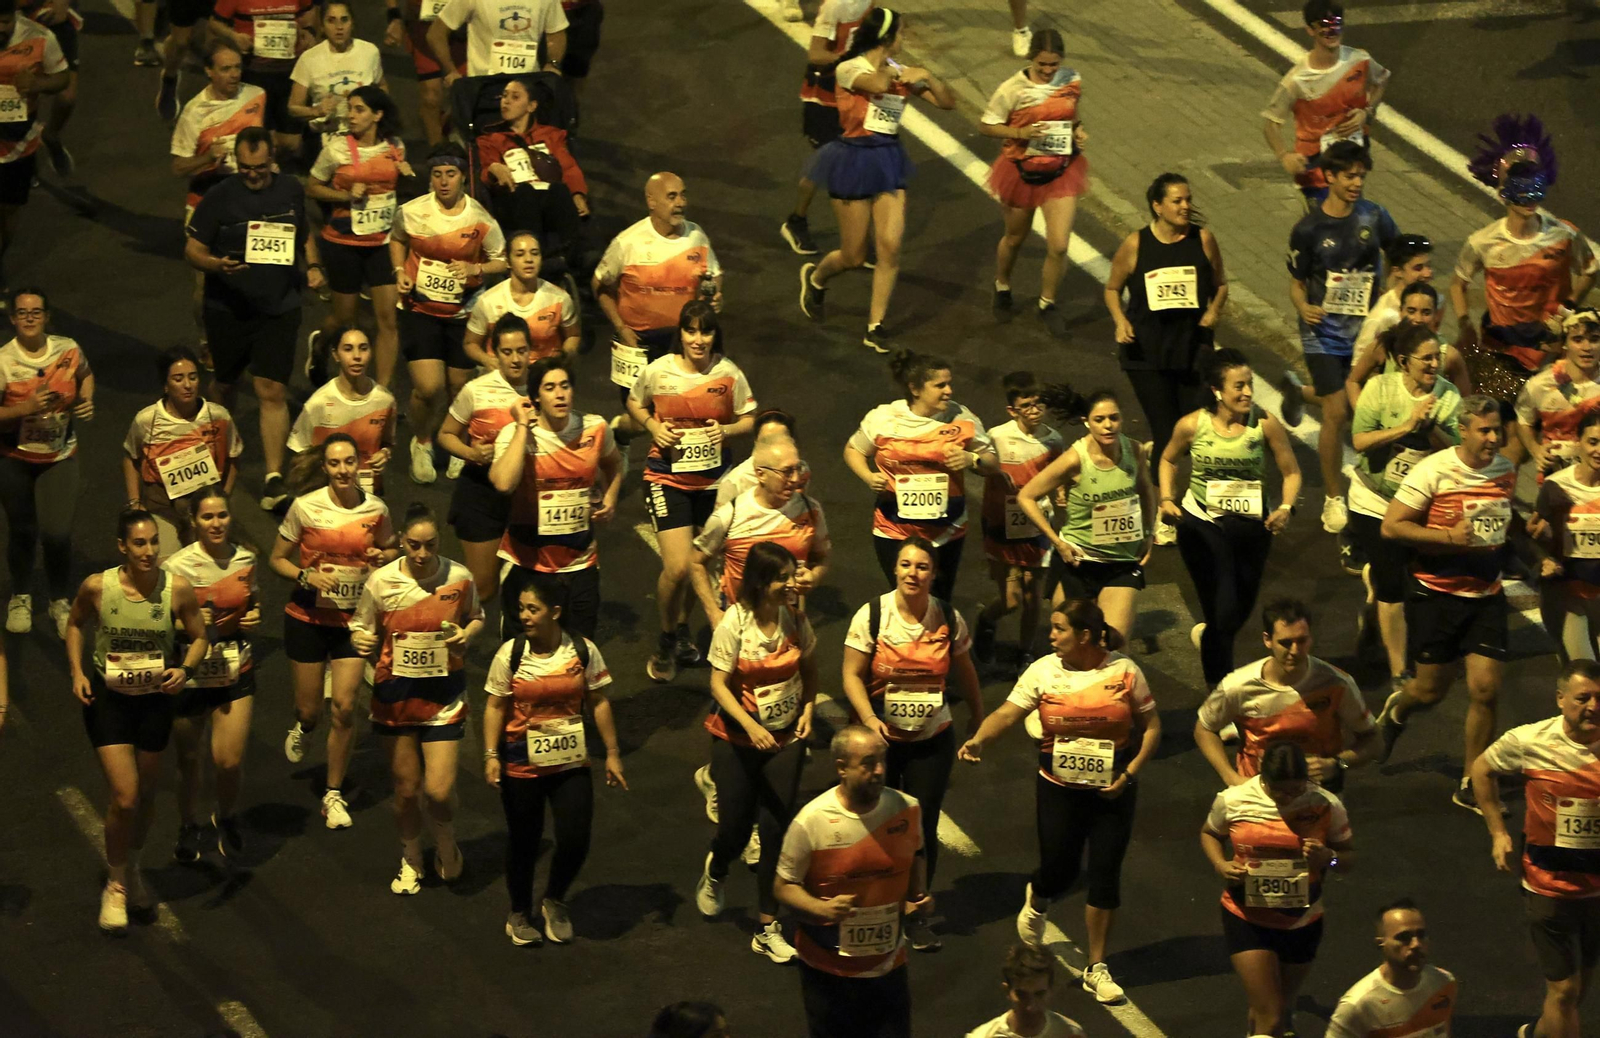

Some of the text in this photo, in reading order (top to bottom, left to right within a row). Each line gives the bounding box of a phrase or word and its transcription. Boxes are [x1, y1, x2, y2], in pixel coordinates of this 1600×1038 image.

[498, 55, 527, 70] 1104
[251, 237, 288, 254] 23451
[424, 275, 456, 293] 3848
[1156, 283, 1188, 299] 3743
[167, 460, 210, 487] 21040
[901, 491, 943, 507] 22006
[1217, 497, 1251, 514] 1800
[545, 505, 586, 523] 14142
[1102, 515, 1135, 533] 1786
[402, 649, 437, 666] 5861
[117, 669, 154, 686] 1818
[890, 702, 935, 718] 23392
[533, 734, 578, 754] 23403
[1058, 753, 1105, 774] 23368
[1252, 878, 1300, 895] 15901
[847, 923, 893, 944] 10749
